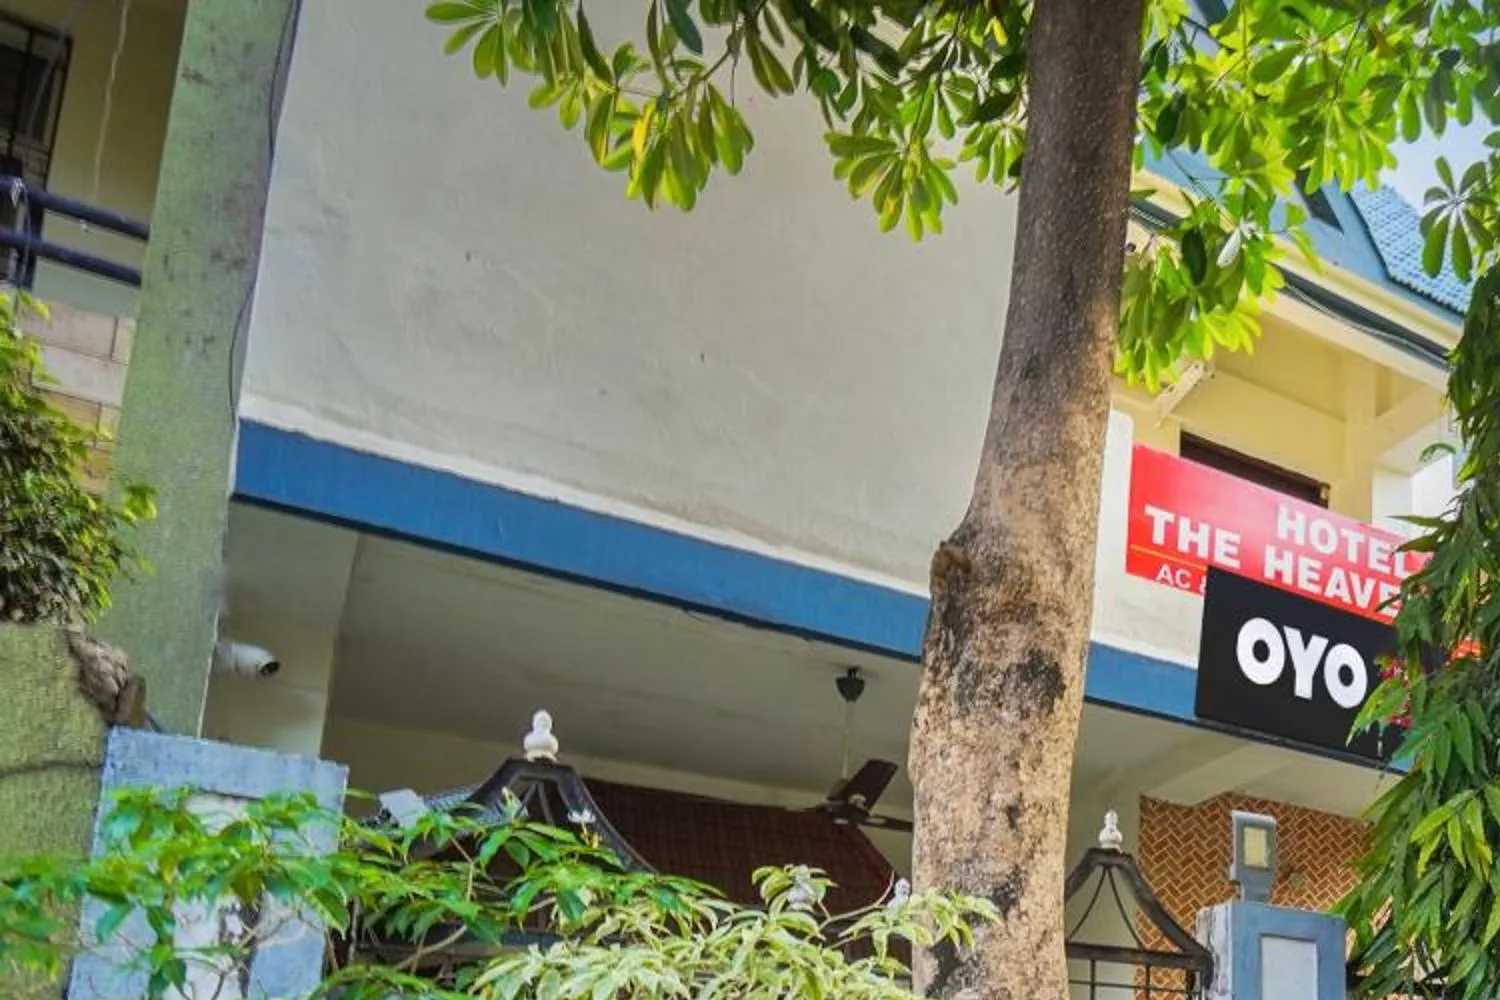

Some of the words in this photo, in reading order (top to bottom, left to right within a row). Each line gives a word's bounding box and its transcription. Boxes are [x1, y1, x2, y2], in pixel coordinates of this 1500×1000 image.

[1144, 503, 1241, 569] THE
[1264, 543, 1402, 618] HEAVE
[1155, 563, 1193, 590] AC
[1278, 505, 1411, 581] HOTEL
[1236, 617, 1368, 709] OYO
